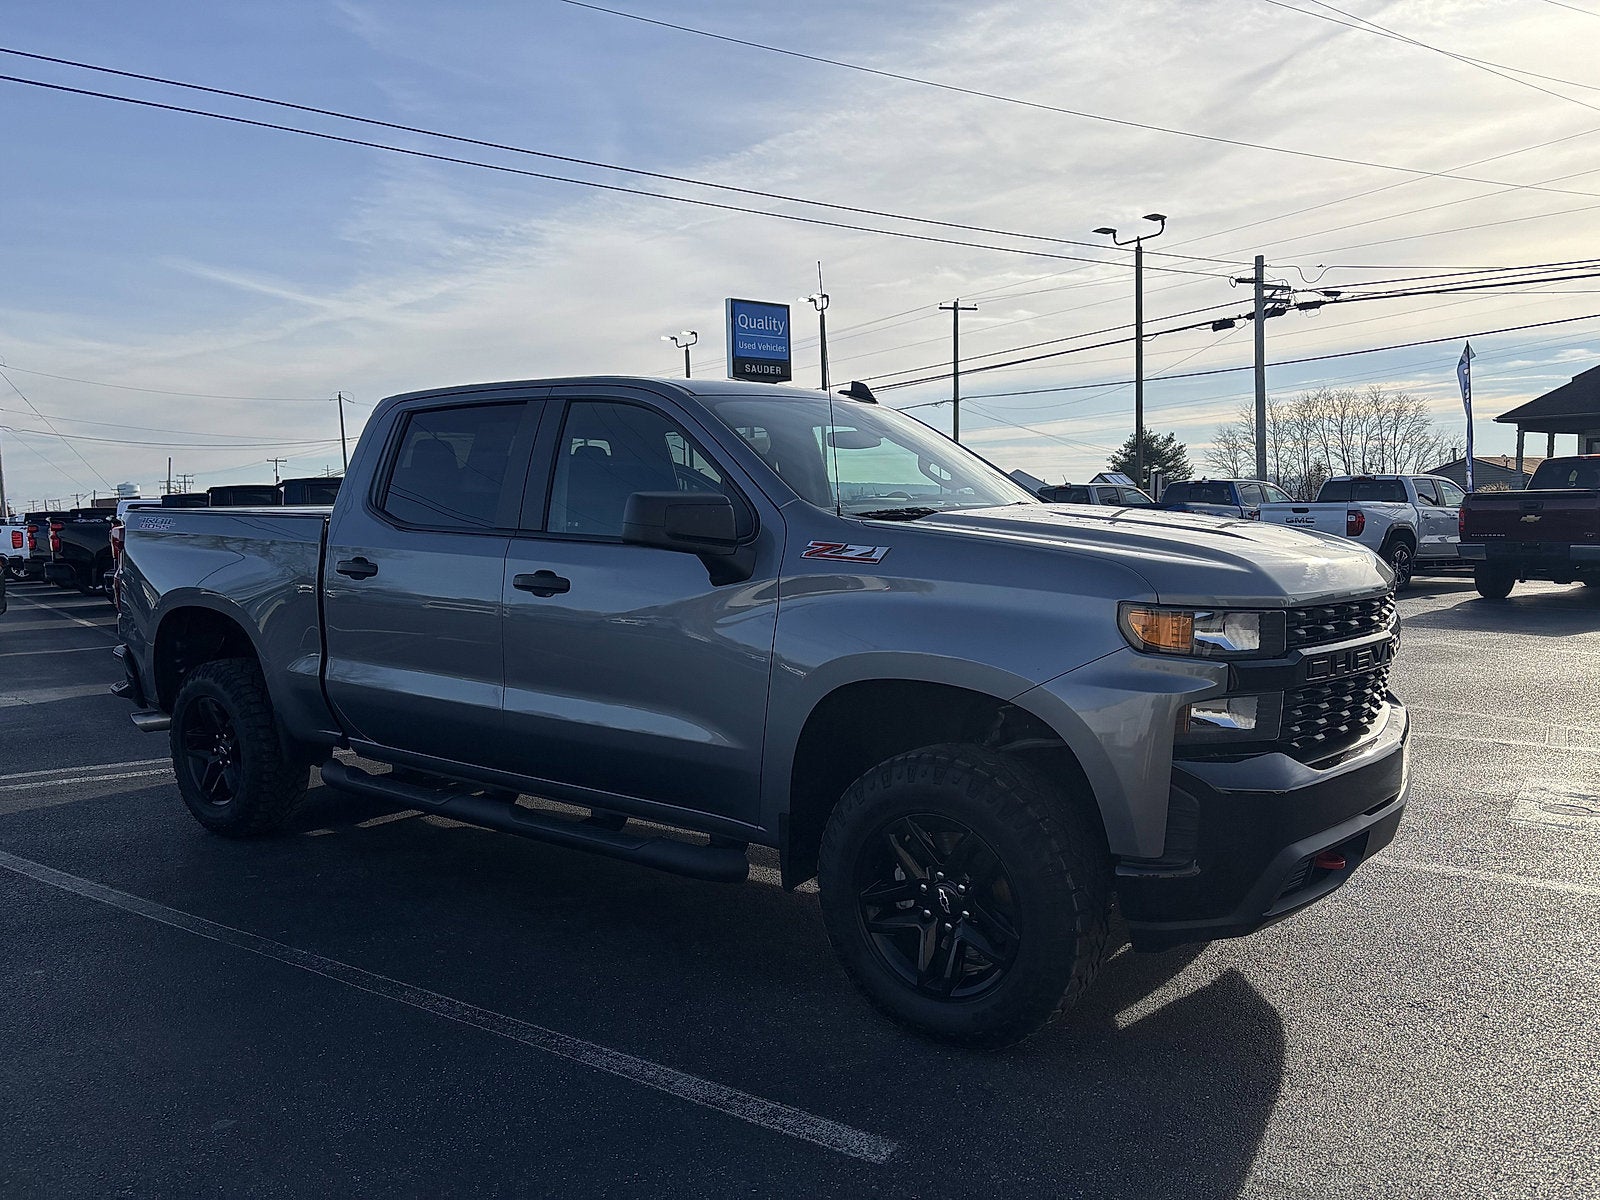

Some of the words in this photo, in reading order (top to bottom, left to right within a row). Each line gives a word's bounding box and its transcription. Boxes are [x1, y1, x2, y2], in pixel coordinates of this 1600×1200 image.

[738, 313, 785, 335] Quality
[738, 341, 756, 350] Used
[757, 342, 786, 353] Vehicles
[744, 363, 782, 375] SAUDER
[800, 540, 890, 565] Z71
